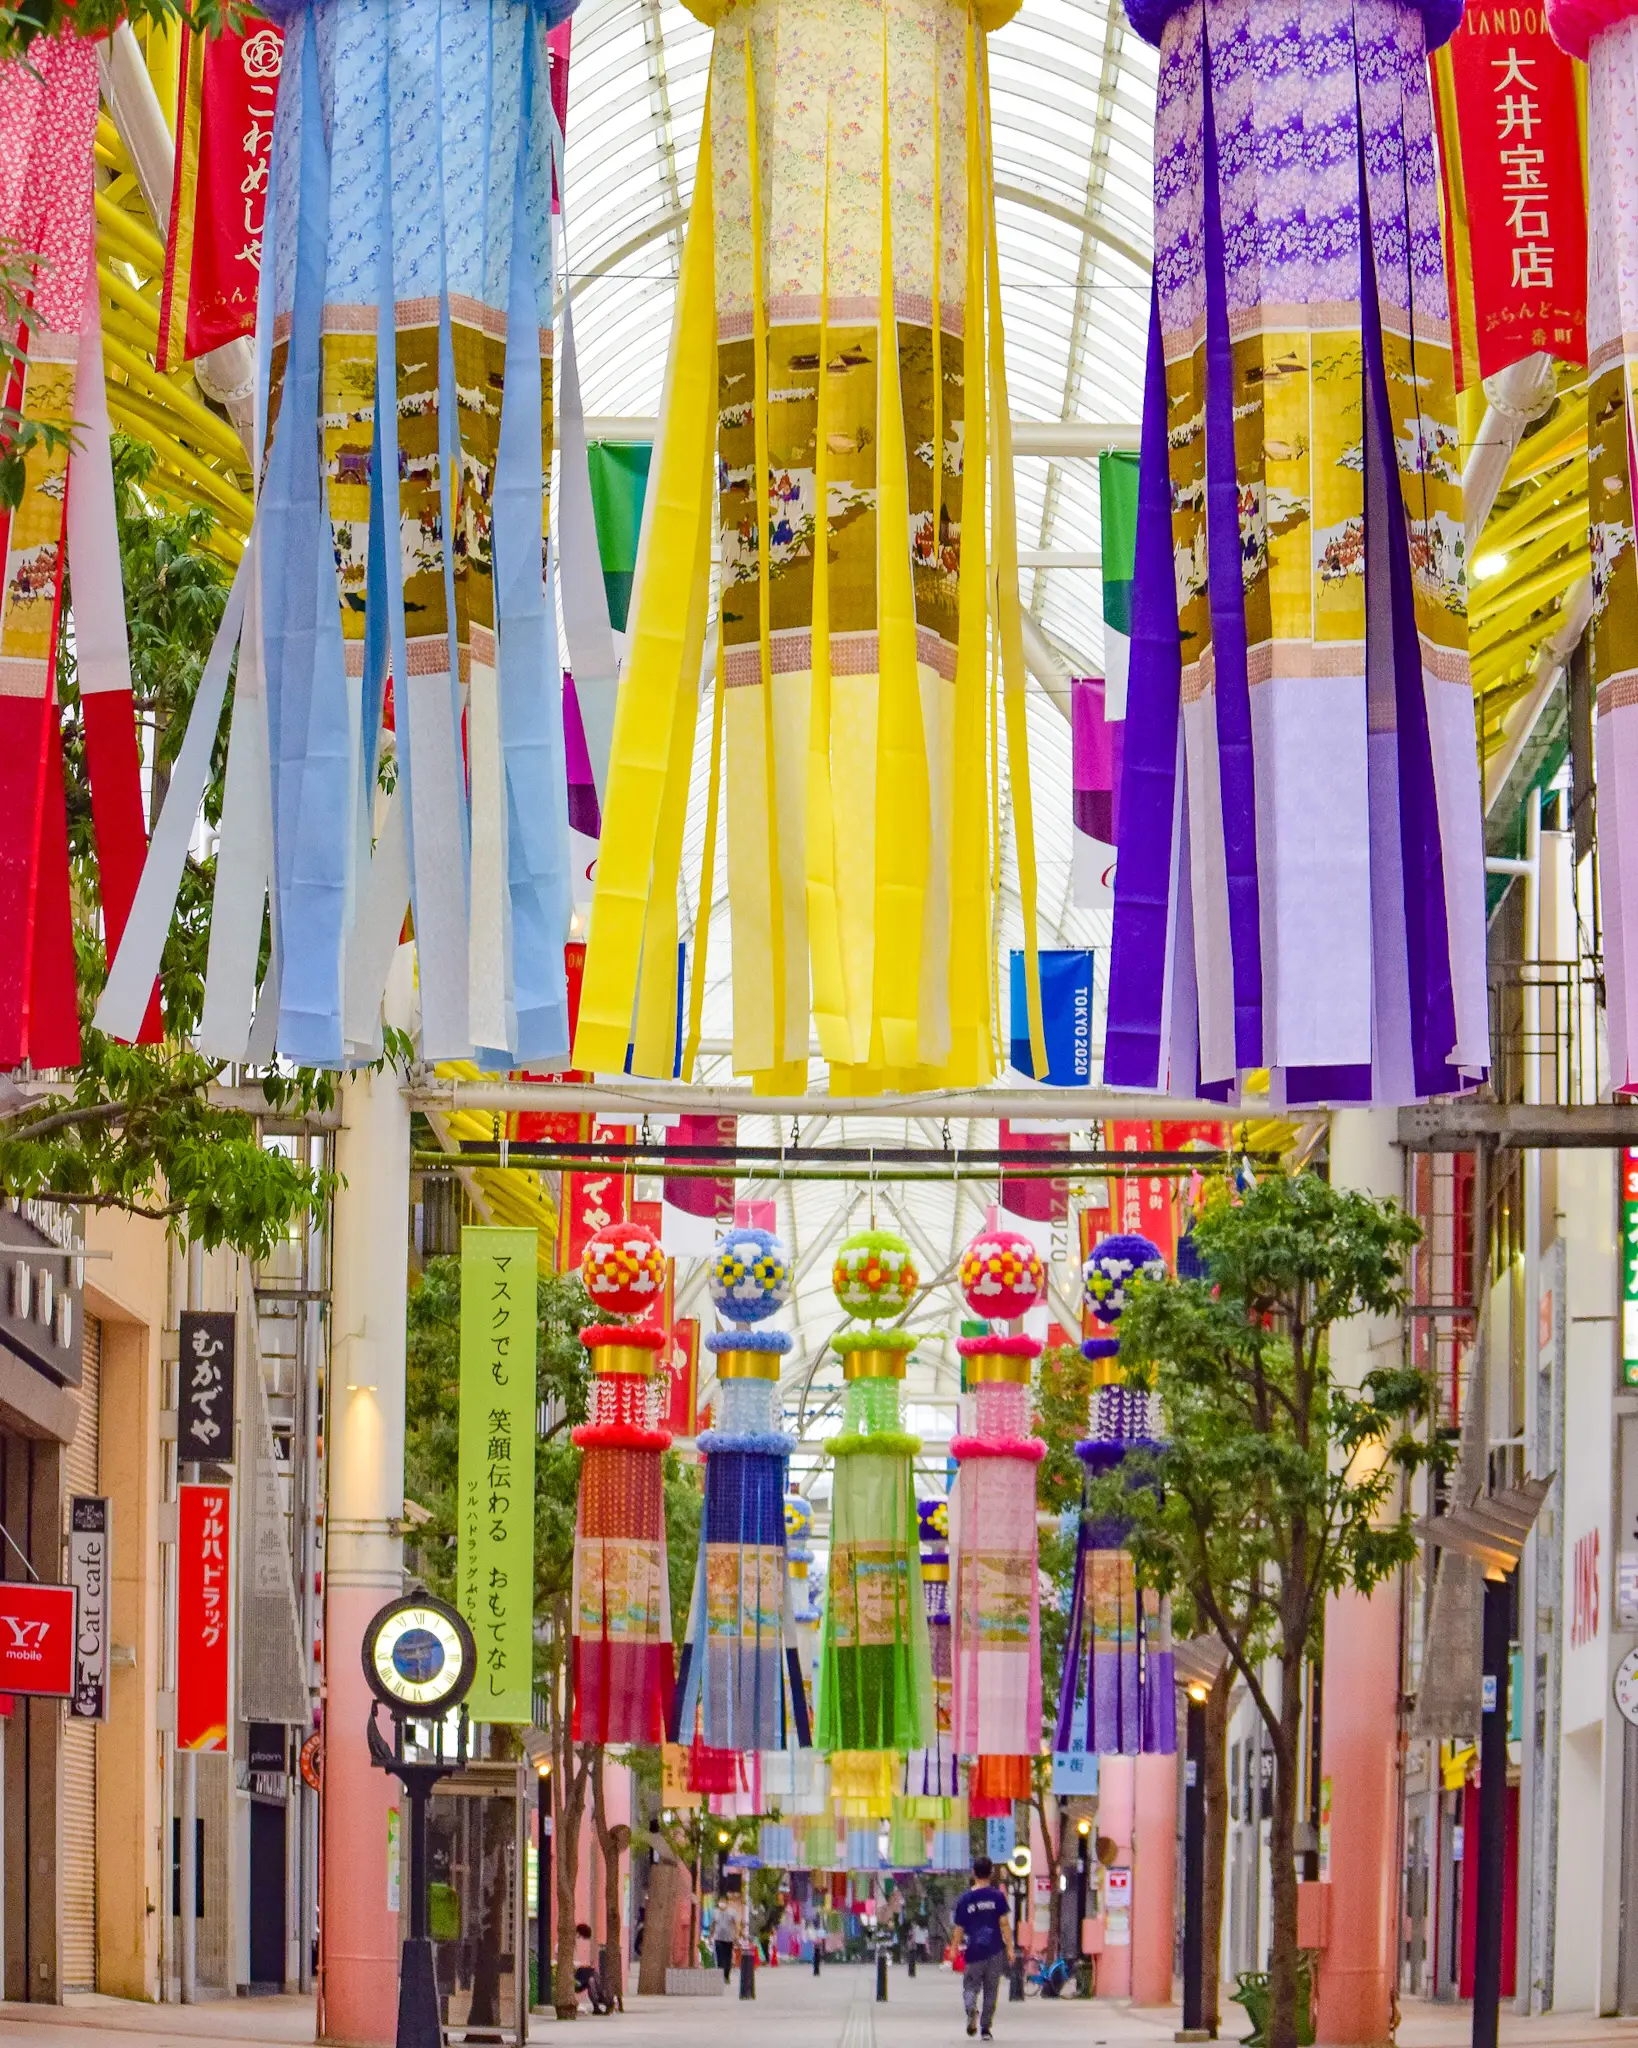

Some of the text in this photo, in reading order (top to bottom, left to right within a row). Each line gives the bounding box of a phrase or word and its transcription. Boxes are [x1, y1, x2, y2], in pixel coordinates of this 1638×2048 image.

[234, 84, 274, 273] こわめしや
[1490, 47, 1555, 289] 大井宝石店
[1073, 986, 1089, 1076] TOKYO 2020
[190, 1328, 224, 1446] むかでや
[486, 1255, 513, 1697] マスクでも 笑顔伝わる おもてなし
[78, 1541, 102, 1598] cafe
[201, 1496, 224, 1648] ツルハドラッグ
[6, 1650, 43, 1662] mobile
[79, 1606, 101, 1657] Cat
